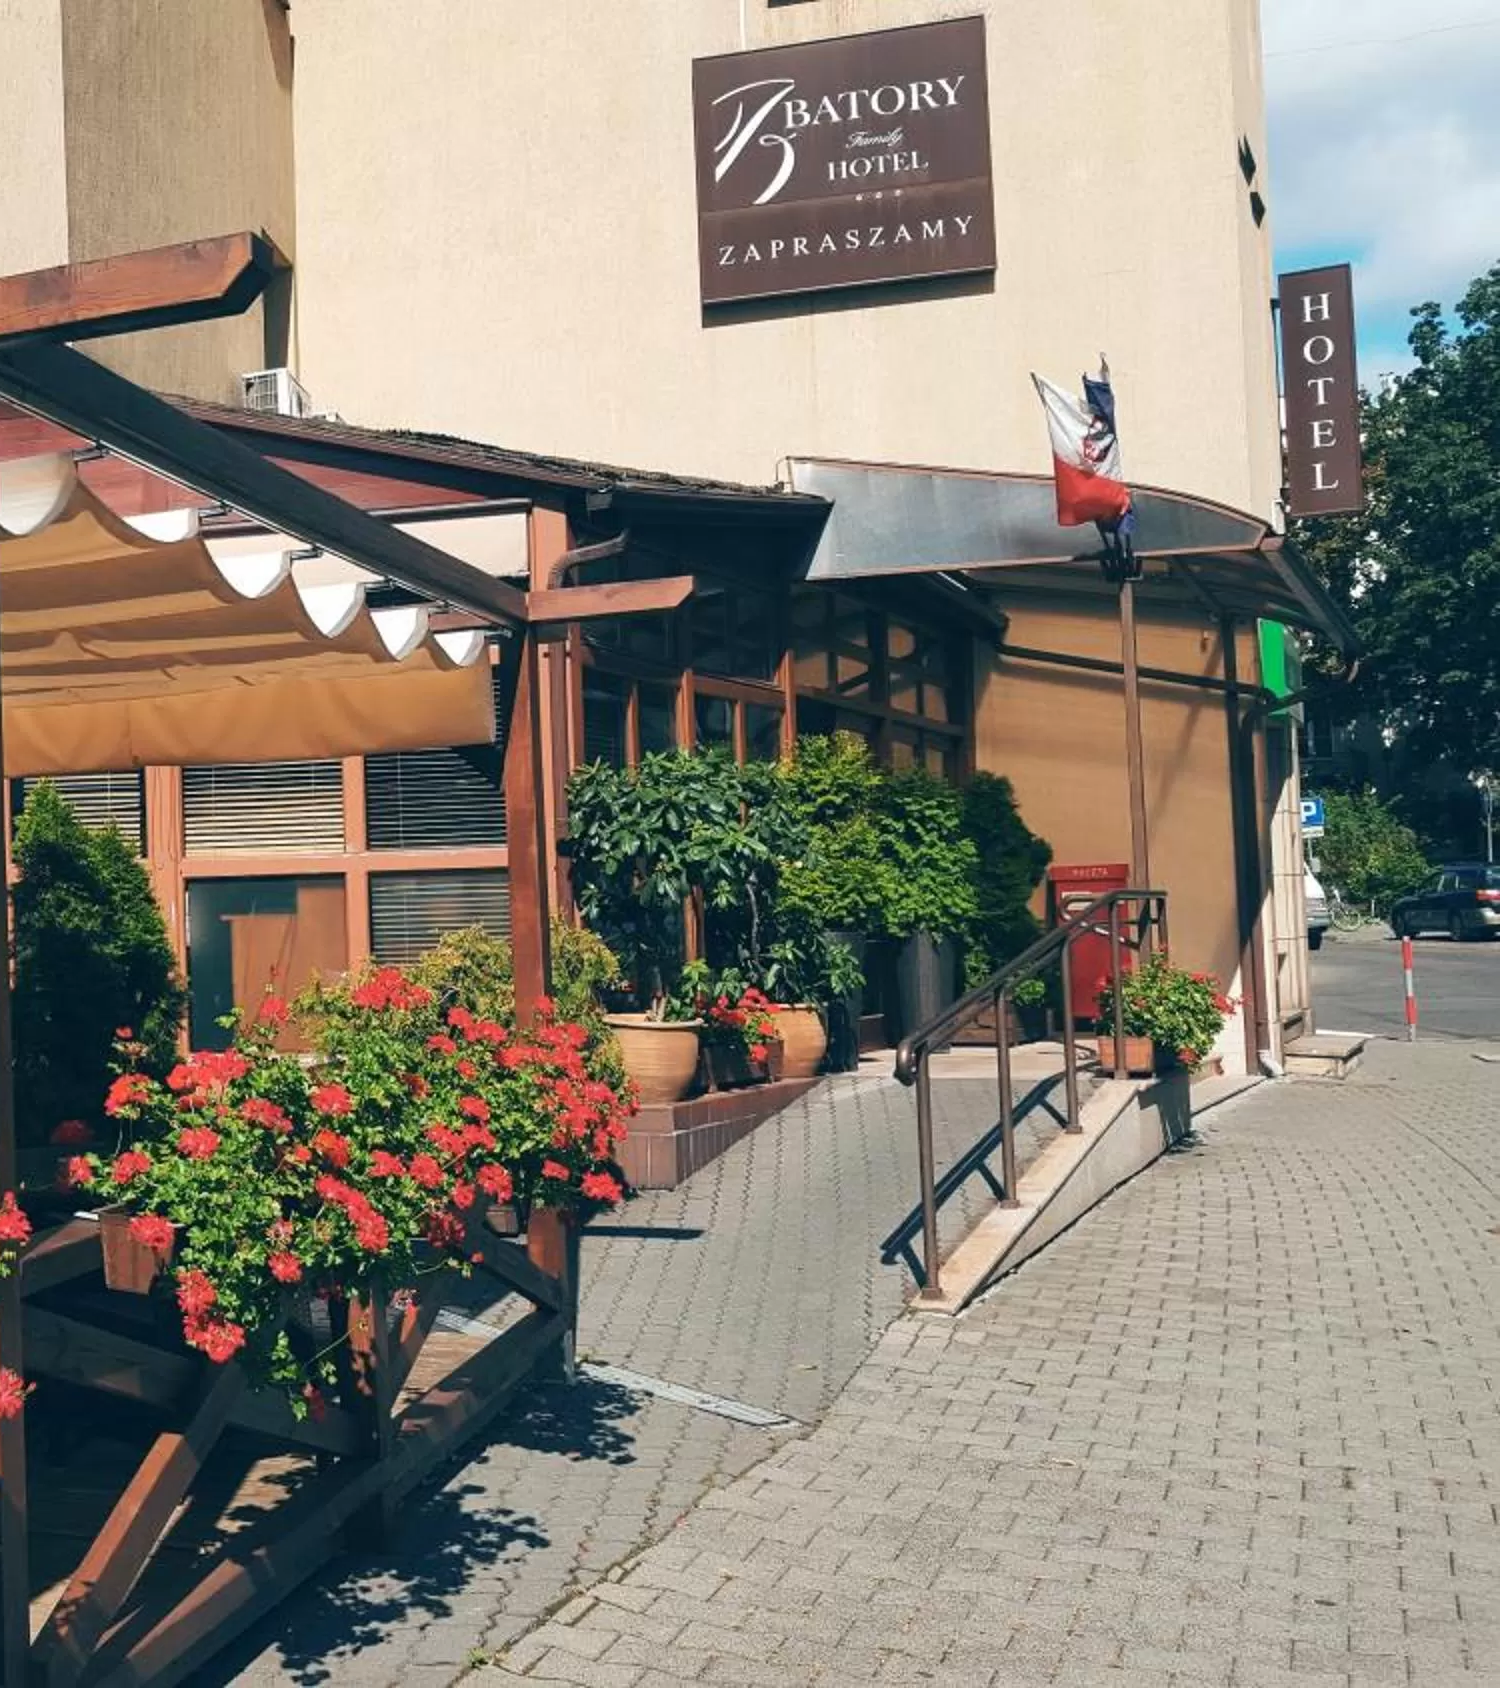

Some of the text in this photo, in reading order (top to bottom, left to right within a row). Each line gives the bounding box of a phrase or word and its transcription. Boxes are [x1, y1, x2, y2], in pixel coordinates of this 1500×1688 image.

[784, 75, 966, 129] BATORY
[827, 150, 930, 182] HOTEL
[718, 214, 974, 267] ZAPRASZAMY
[1302, 291, 1340, 491] HOTEL
[1299, 801, 1317, 823] P
